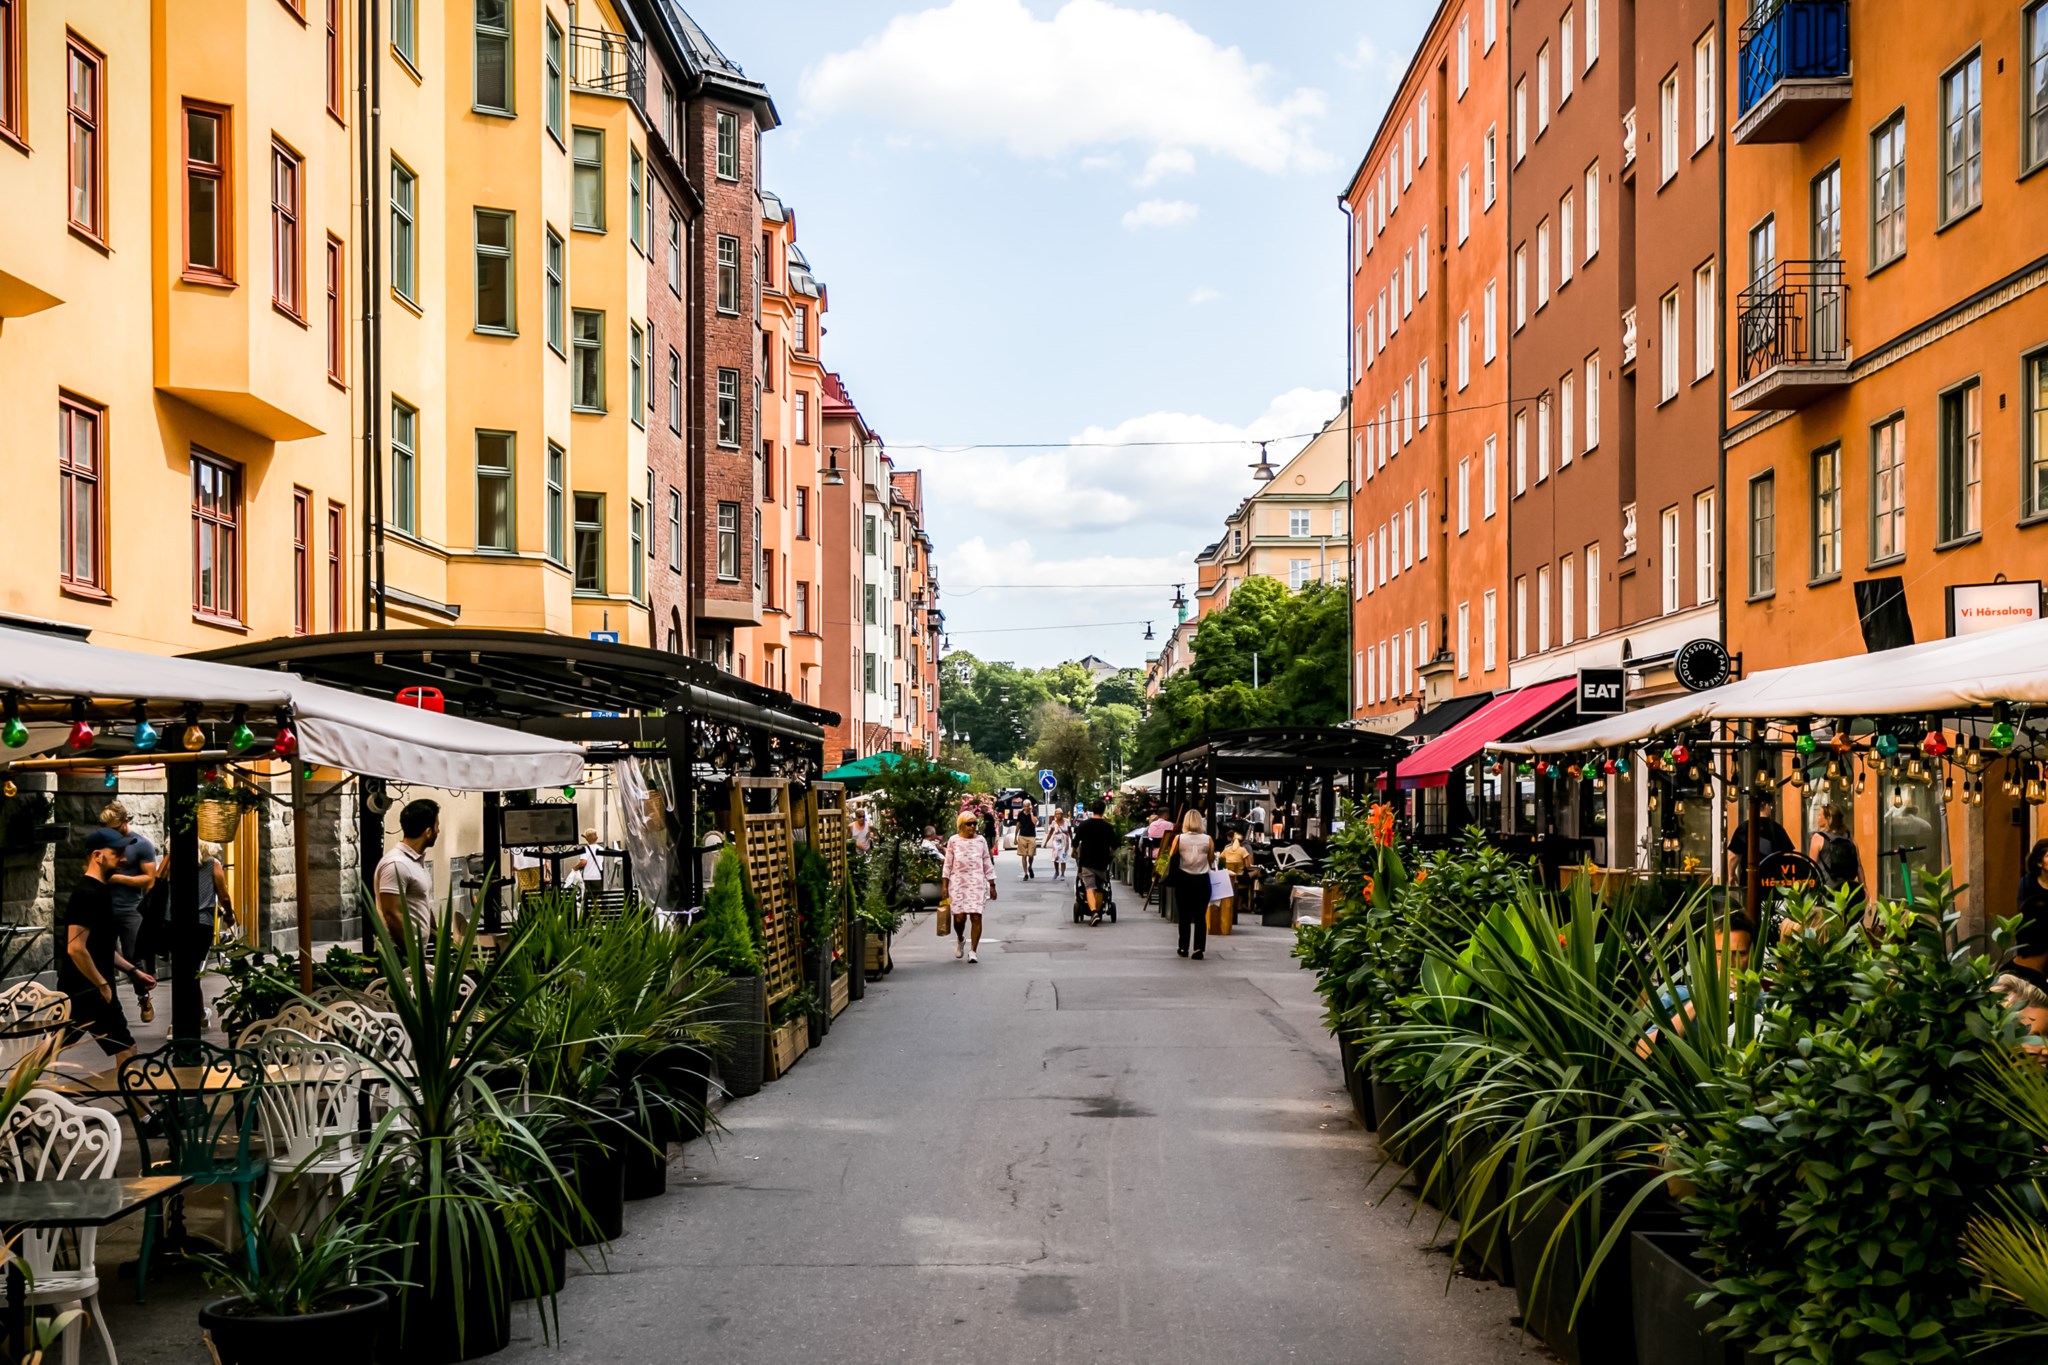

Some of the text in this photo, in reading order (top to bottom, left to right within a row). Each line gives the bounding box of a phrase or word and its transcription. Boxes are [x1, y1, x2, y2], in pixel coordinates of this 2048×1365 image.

[1961, 606, 2033, 617] Vi Hårsalong
[1681, 643, 1713, 681] ADOLFSSON
[1699, 654, 1726, 688] PARTNERS
[1584, 683, 1620, 698] EAT
[1781, 864, 1796, 875] VI
